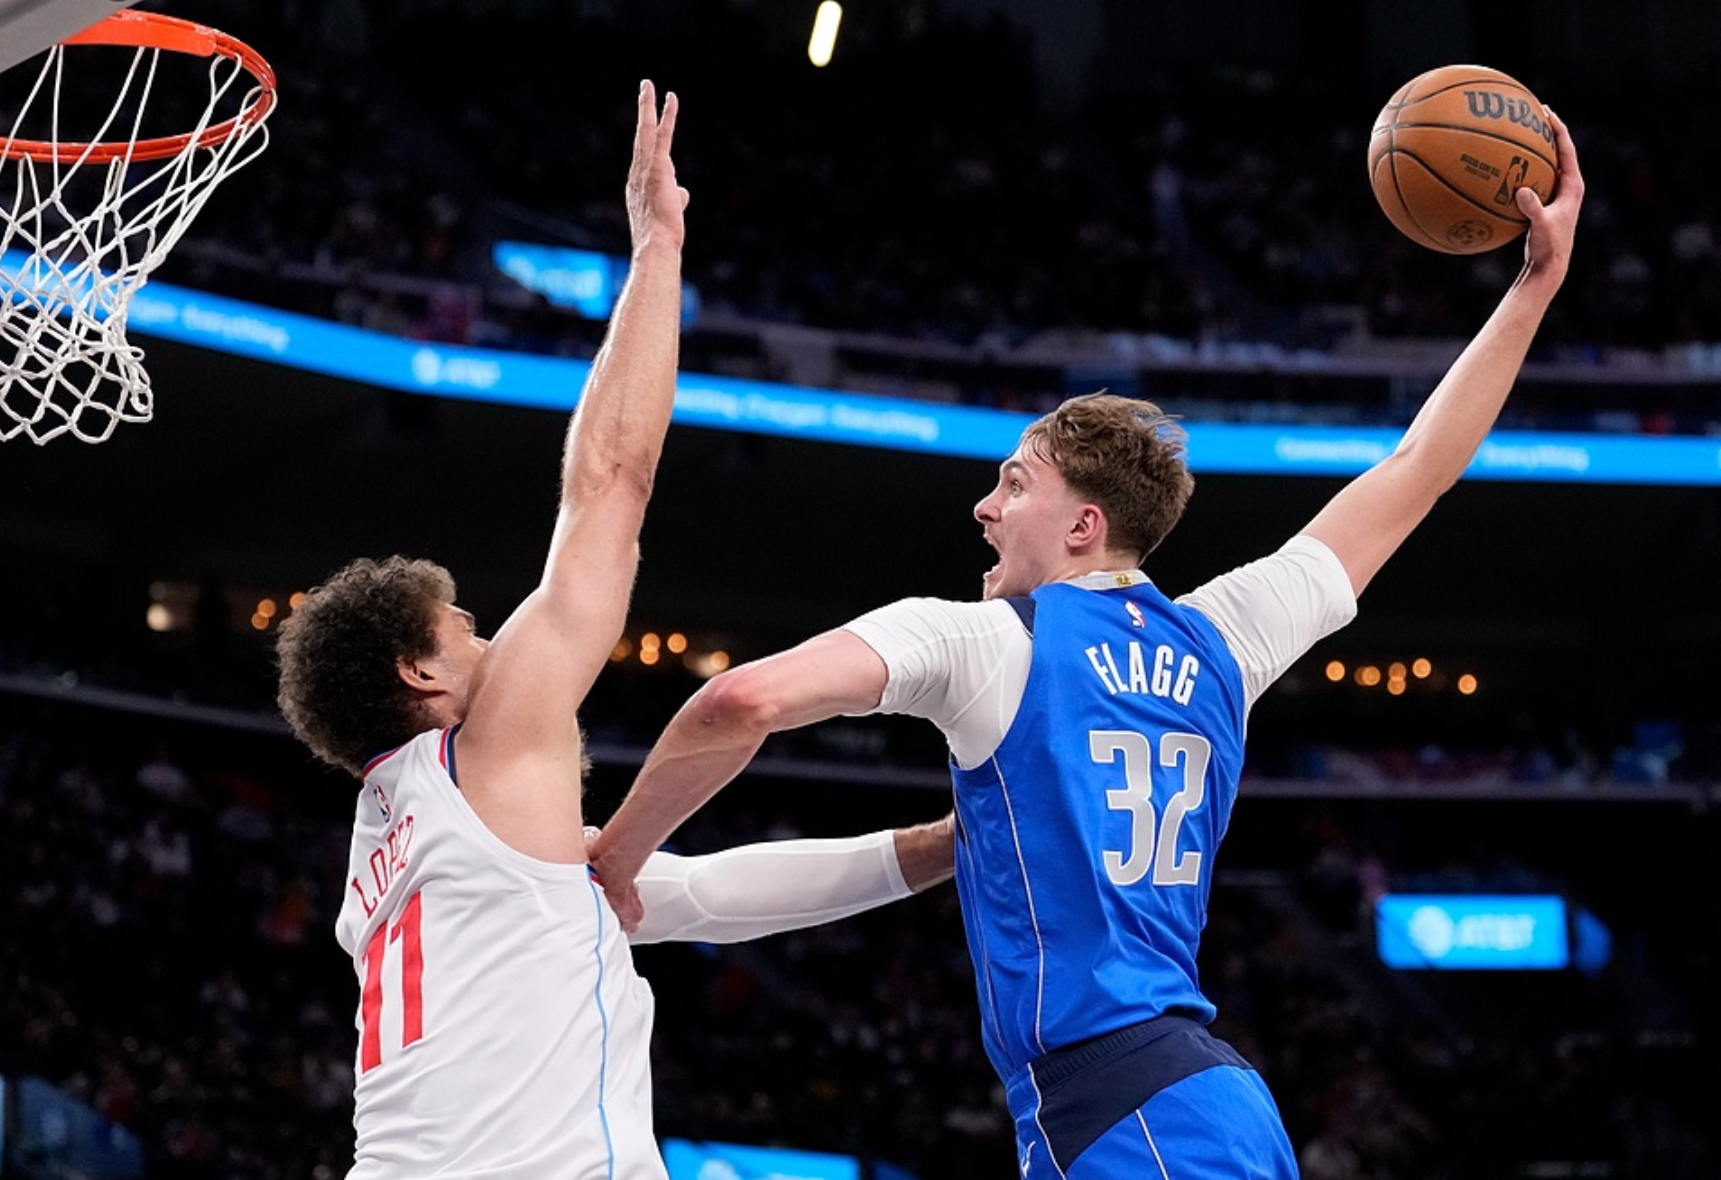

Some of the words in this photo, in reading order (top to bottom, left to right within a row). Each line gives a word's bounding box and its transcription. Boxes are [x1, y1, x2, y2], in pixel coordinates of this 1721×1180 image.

[1085, 641, 1200, 706] FLAGG
[1089, 729, 1212, 886] 32
[361, 890, 424, 1073] 11
